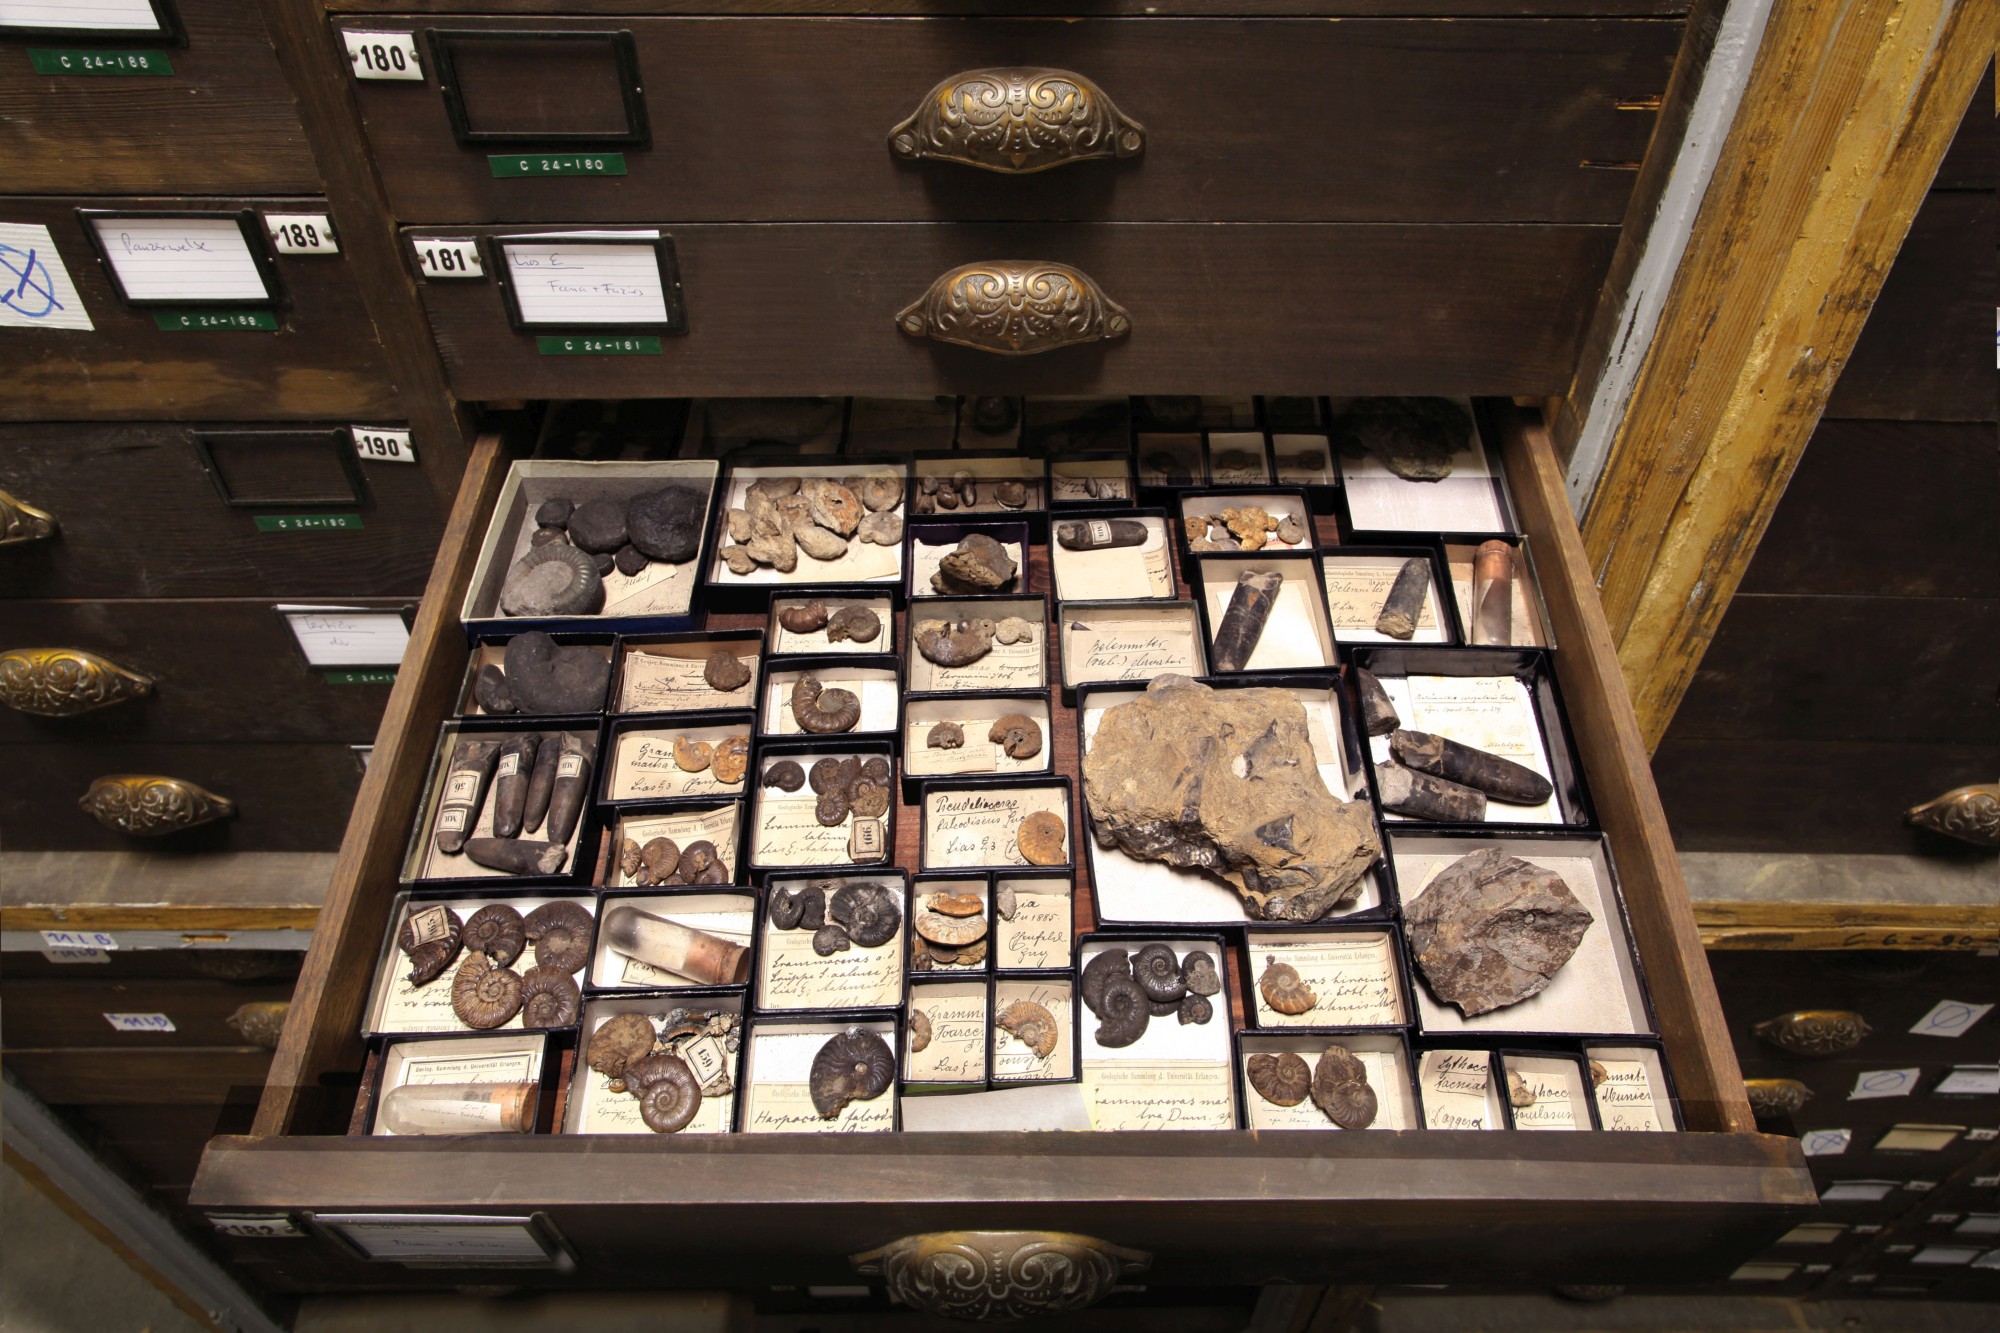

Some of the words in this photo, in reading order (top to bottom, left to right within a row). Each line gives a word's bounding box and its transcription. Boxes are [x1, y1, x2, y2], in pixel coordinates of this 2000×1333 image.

[60, 56, 71, 68] C
[82, 56, 149, 69] 24-188
[359, 44, 407, 72] 180
[519, 160, 529, 171] C
[541, 159, 604, 171] 24-180
[279, 223, 321, 249] 189
[425, 248, 468, 272] 181
[181, 316, 191, 326] C
[565, 342, 574, 351] C
[584, 341, 641, 351] 24-181
[363, 435, 401, 458] 190
[278, 519, 287, 529] C
[295, 518, 347, 528] 24-190
[346, 674, 354, 682] C
[435, 1064, 462, 1073] Sammlung
[1129, 1071, 1157, 1082] Sammlung
[231, 1223, 275, 1237] 182
